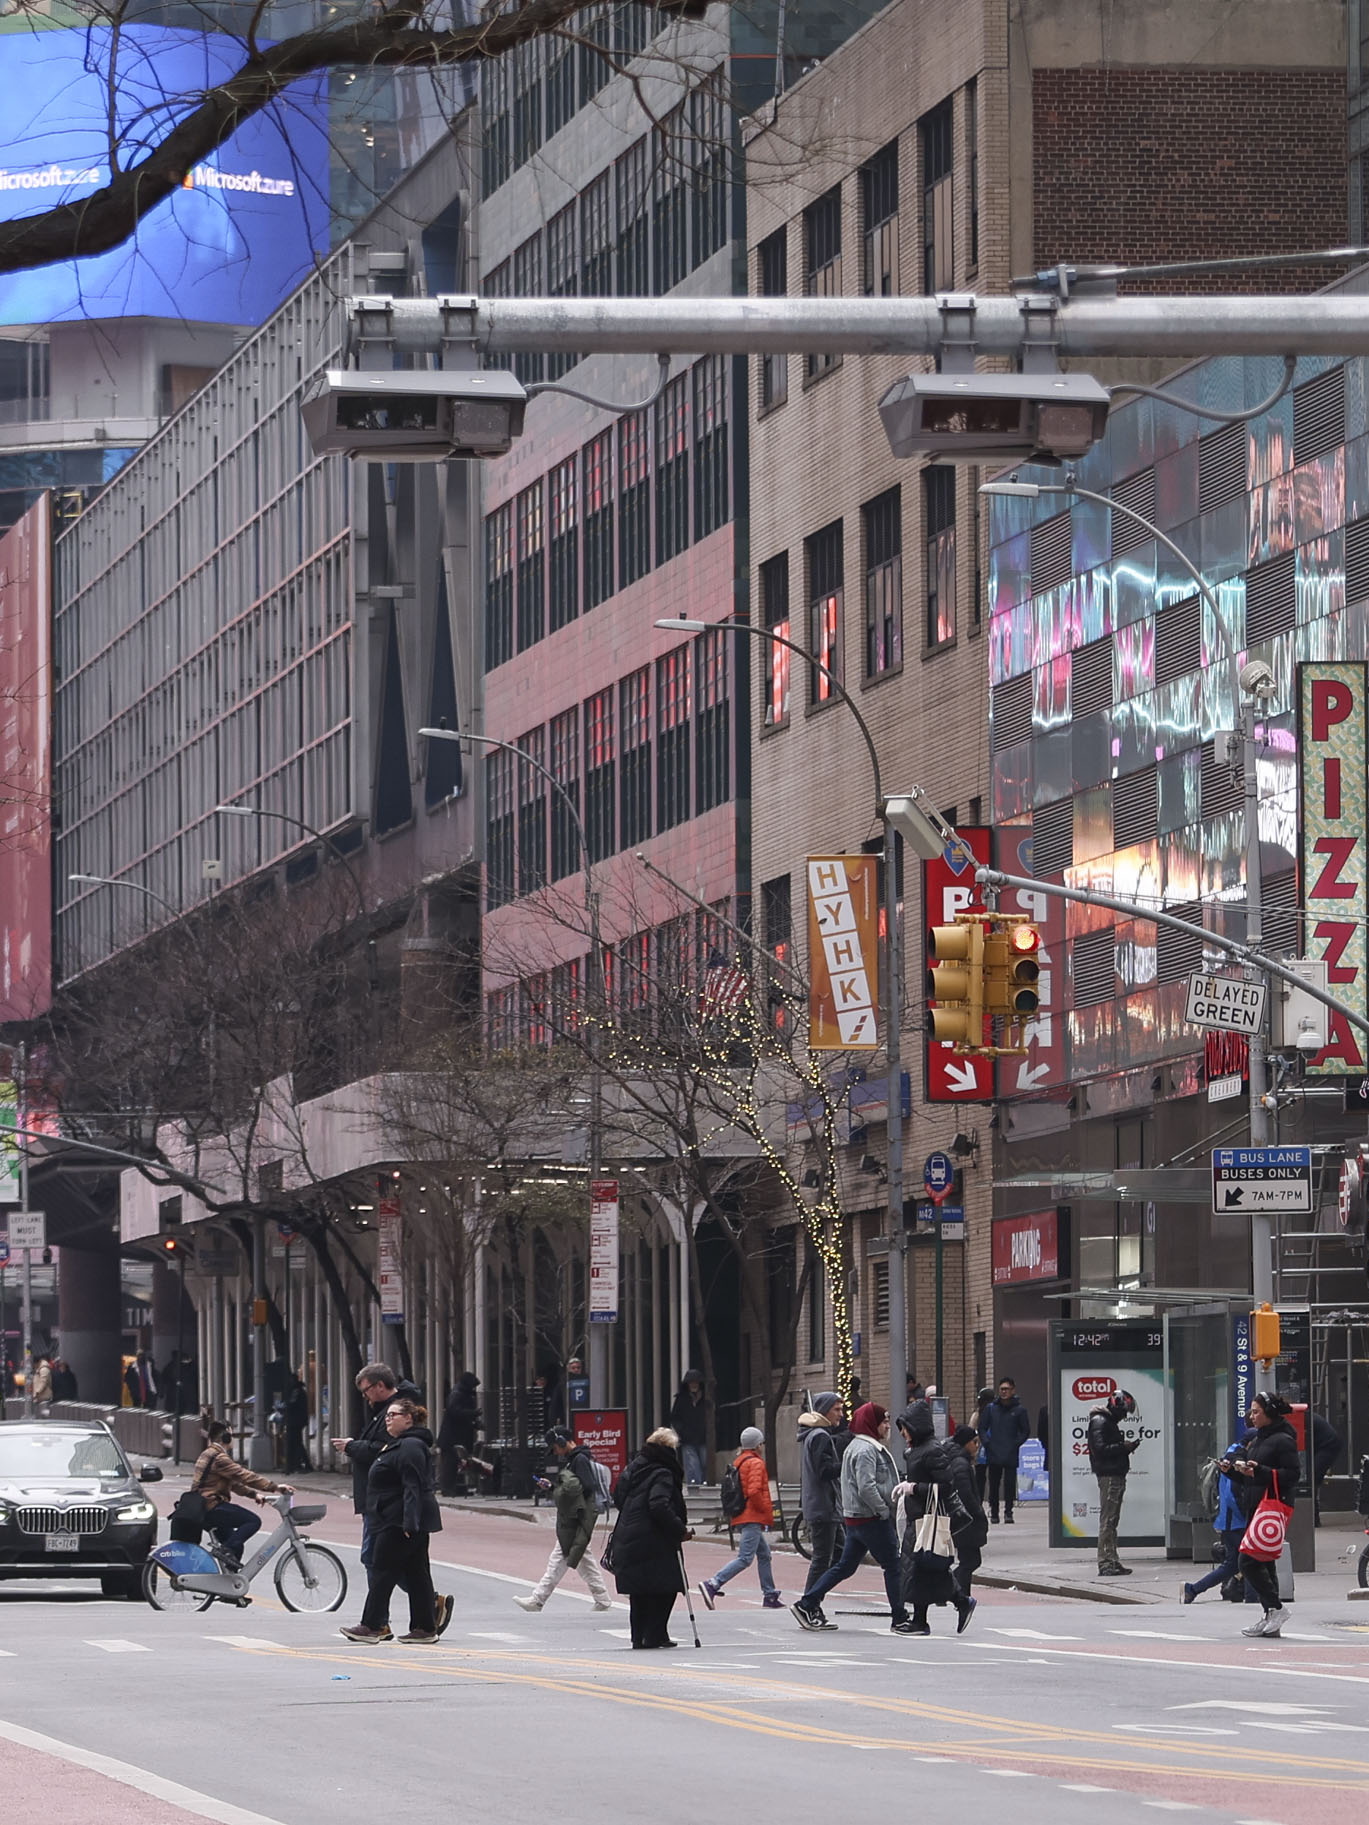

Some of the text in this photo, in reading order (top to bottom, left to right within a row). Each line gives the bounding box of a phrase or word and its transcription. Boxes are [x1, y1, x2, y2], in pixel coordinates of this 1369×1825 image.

[1307, 680, 1363, 1066] PIZZA
[1195, 980, 1259, 1006] DELAYED
[1194, 1001, 1255, 1027] GREEN
[1239, 1152, 1303, 1163] BUS LANE
[1221, 1167, 1302, 1179] BUSES ONLY
[1252, 1190, 1302, 1201] 7AM-7PM
[16, 1226, 36, 1234] MUST
[1011, 1229, 1041, 1269] PARKING
[1072, 1333, 1100, 1346] 12:42
[1237, 1337, 1248, 1351] St
[1237, 1353, 1248, 1362] &
[1237, 1364, 1248, 1373] 9
[1077, 1379, 1111, 1393] total
[575, 1389, 584, 1401] P
[1237, 1375, 1248, 1418] Avenue
[578, 1429, 621, 1440] Early Bird
[1138, 1426, 1161, 1439] for
[583, 1439, 617, 1448] Special
